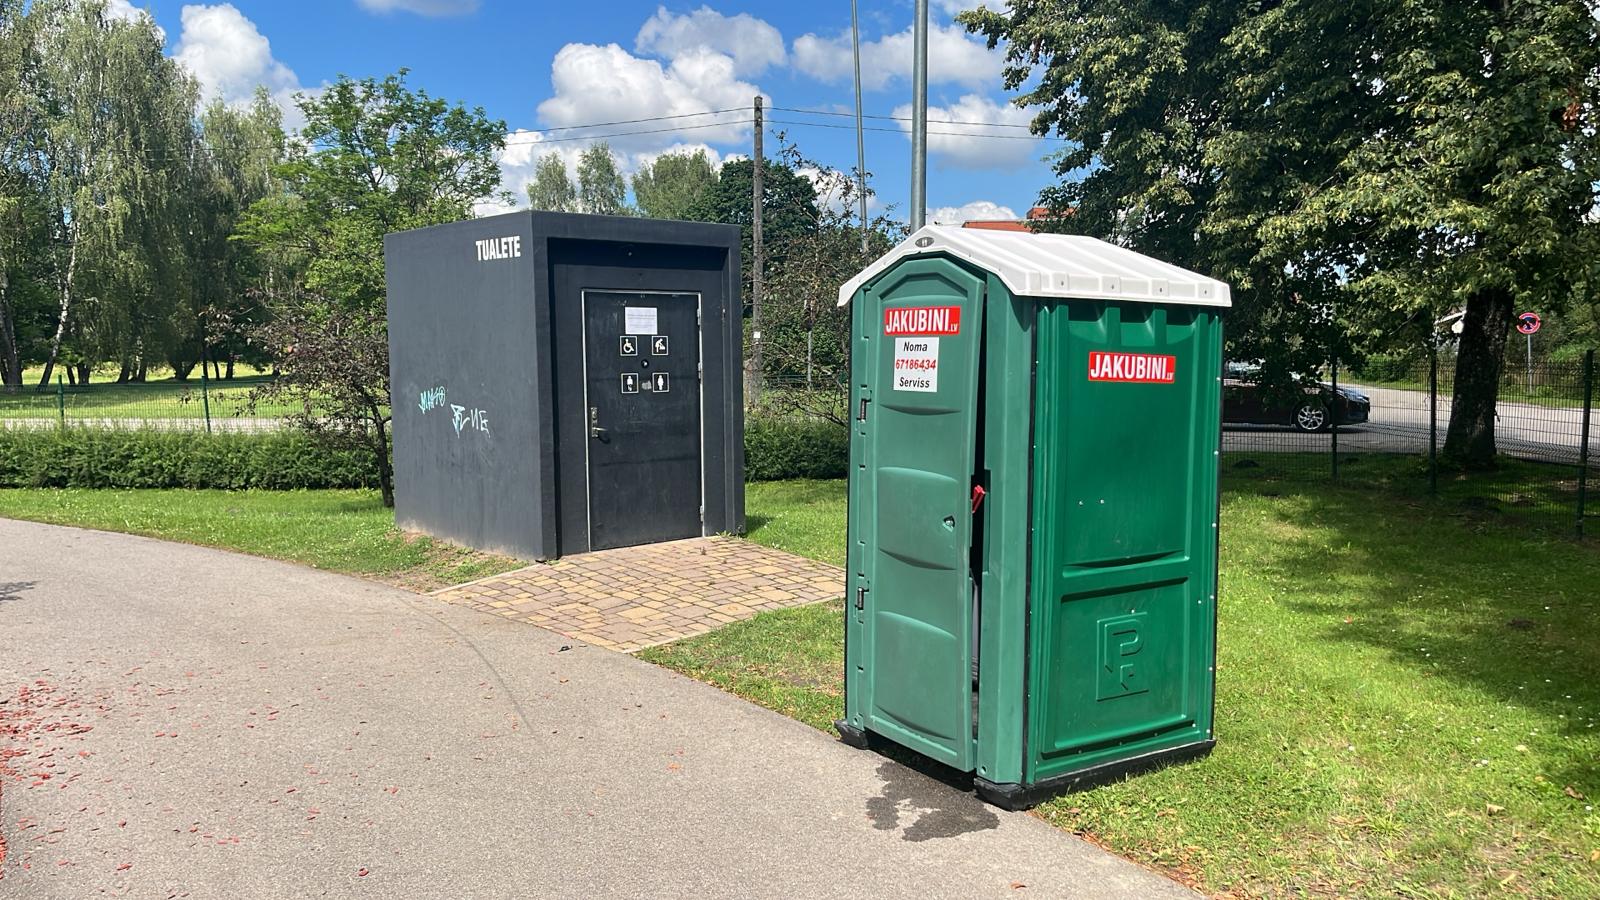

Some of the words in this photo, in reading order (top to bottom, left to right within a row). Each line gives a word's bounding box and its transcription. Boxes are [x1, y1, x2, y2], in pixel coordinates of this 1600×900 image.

[475, 235, 521, 261] TUALETE
[903, 341, 928, 352] Noma
[895, 359, 937, 370] 67186434
[899, 376, 930, 388] Serviss
